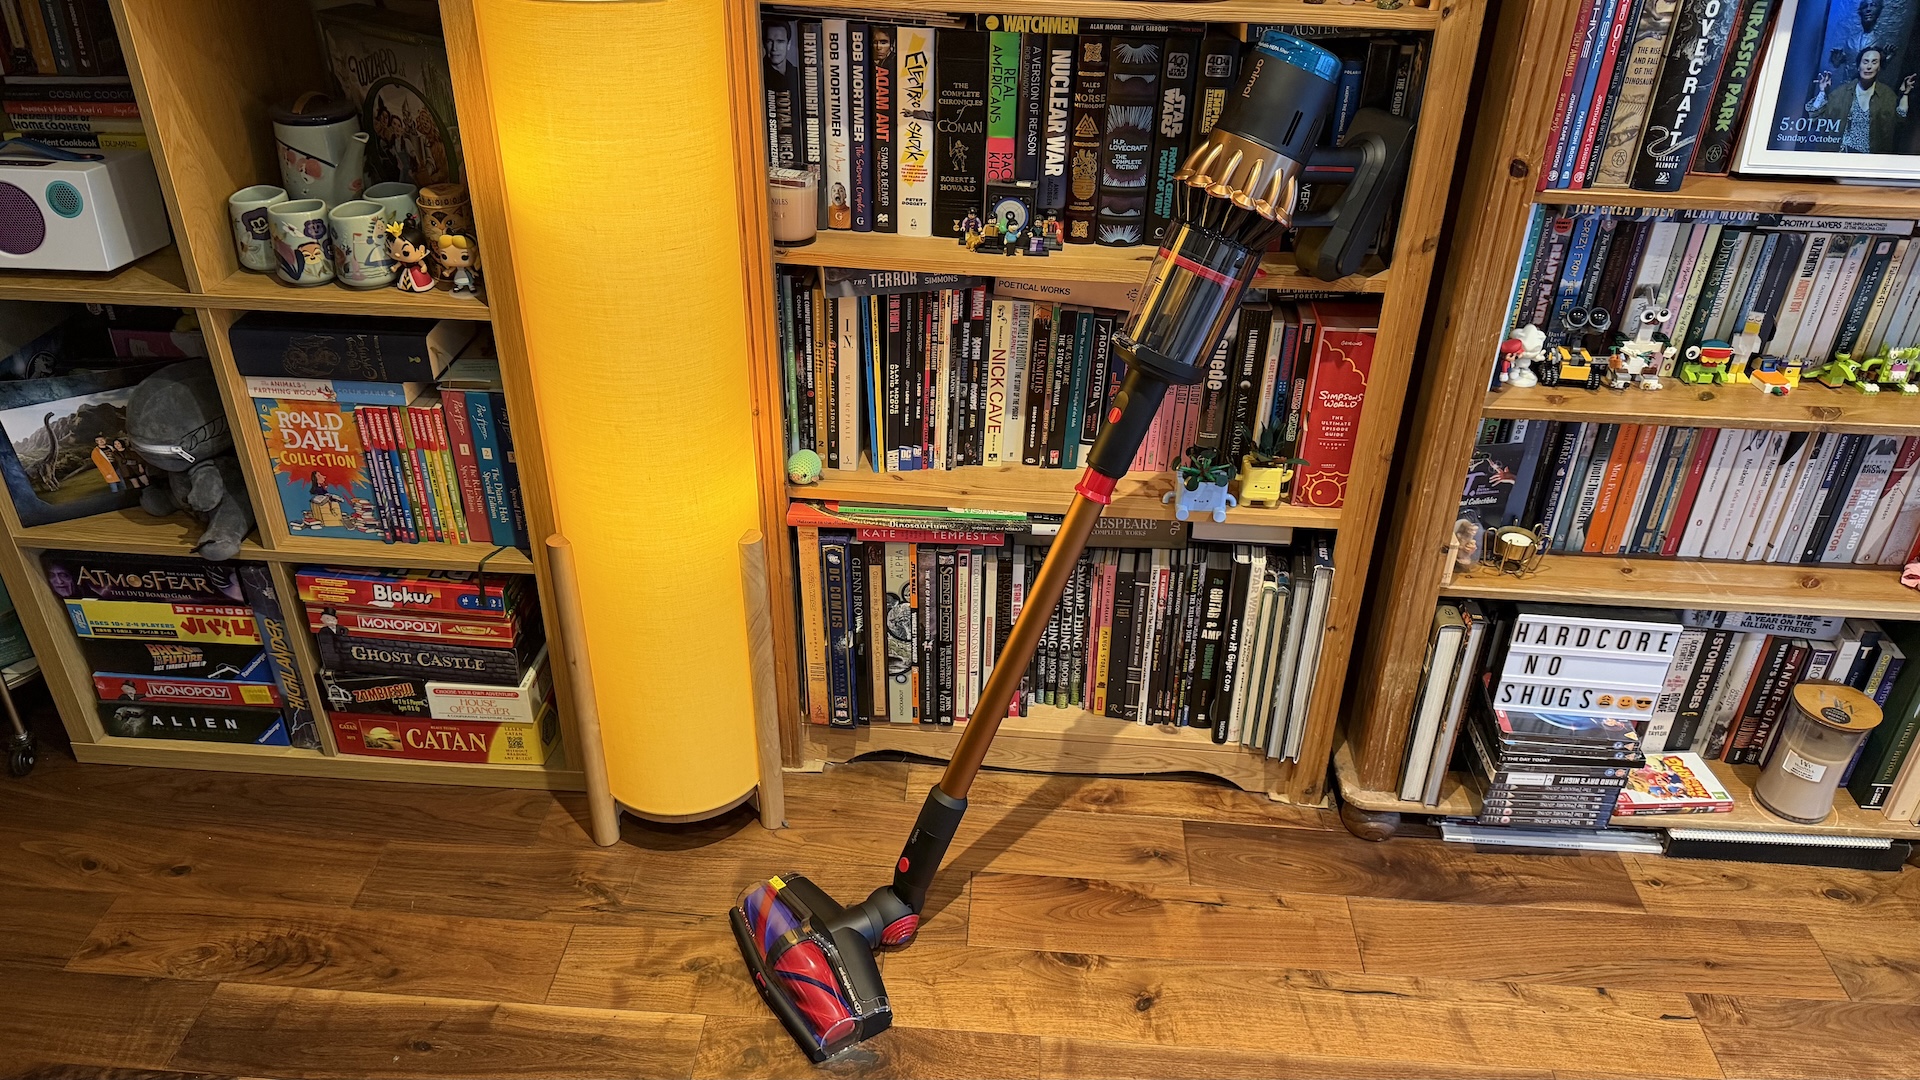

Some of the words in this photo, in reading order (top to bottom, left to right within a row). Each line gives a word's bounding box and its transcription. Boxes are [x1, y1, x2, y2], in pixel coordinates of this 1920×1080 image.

[1003, 15, 1079, 35] WATCHMEN
[1580, 8, 1600, 59] HIVE
[804, 32, 817, 65] DEXYS
[829, 32, 839, 63] BOB
[852, 32, 864, 62] BOB
[1591, 22, 1610, 69] SKULL
[1637, 46, 1648, 54] THE
[1649, 47, 1662, 55] RISE
[1633, 56, 1646, 64] AND
[1646, 57, 1659, 65] FALL
[1634, 67, 1642, 75] OF
[1642, 67, 1653, 75] THE
[804, 66, 819, 115] MIDNIGHT
[875, 67, 890, 110] ADAM
[989, 45, 1003, 124] AMERICANS
[1003, 68, 1016, 101] REAL
[1242, 58, 1265, 98] animal
[48, 91, 91, 100] COSMIC
[830, 65, 842, 137] MORTIMER
[853, 65, 865, 143] MORTIMER
[938, 98, 984, 107] CHRONICLES
[941, 90, 981, 98] COMPLETE
[1047, 50, 1072, 133] NUCLEAR
[1566, 93, 1576, 122] JONATHAN
[877, 113, 890, 142] ANT
[937, 120, 983, 134] CONAN
[1561, 122, 1569, 137] CAPE
[1780, 117, 1813, 133] 5:01
[1816, 118, 1841, 133] PM
[60, 139, 97, 148] Cookbook
[806, 117, 821, 163] RUNNERS
[1109, 144, 1148, 152] LOVECRAFT
[1776, 133, 1807, 145] Sunday,
[1808, 134, 1843, 144] October
[1045, 136, 1066, 177] WAR
[1553, 138, 1564, 168] LONDON
[1579, 218, 1594, 251] CRAZY
[1816, 220, 1843, 229] SAYERS
[1545, 243, 1563, 283] READY
[1571, 253, 1583, 278] FROM
[854, 278, 867, 286] THE
[869, 271, 918, 288] TERROR
[925, 275, 959, 284] SIMMONS
[998, 280, 1039, 291] POETICAL
[1040, 286, 1071, 295] WORKS
[973, 291, 984, 318] MARVEL
[1533, 284, 1552, 325] PLAYER
[1010, 326, 1018, 360] FEARNLEY
[1036, 338, 1047, 357] THE
[1098, 334, 1106, 359] ROCK
[1243, 329, 1258, 376] ILLUMINATIONS
[989, 350, 1007, 388] NICK
[1034, 358, 1046, 394] SMITHS
[1207, 338, 1228, 390] suede
[253, 385, 288, 395] FARTHING
[293, 387, 317, 396] WOOD
[1093, 361, 1104, 400] BOTTOM
[1318, 390, 1364, 402] SIMPSONS
[1324, 400, 1358, 409] WORLD
[275, 410, 344, 432] ROALD
[987, 392, 1005, 434] CAVE
[280, 429, 349, 452] DAHL
[1557, 432, 1576, 465] HARRIS
[1836, 435, 1848, 459] GRAHAM
[279, 450, 357, 469] COLLECTION
[1611, 462, 1623, 482] MOLL
[1827, 460, 1839, 482] GREENE
[1739, 458, 1754, 487] Murakami
[1761, 459, 1776, 488] Murakami
[1782, 461, 1796, 489] Murakami
[1801, 462, 1815, 490] Murakami
[1599, 483, 1617, 514] FLANDERS
[1846, 489, 1861, 509] PHIL
[1854, 489, 1868, 511] FALL
[1865, 488, 1879, 507] THE
[889, 521, 950, 531] Dinosaurium
[1828, 511, 1852, 552] SPECTOR
[1849, 513, 1859, 525] OF
[1855, 509, 1870, 529] RISE
[862, 529, 896, 539] KATE
[932, 532, 988, 543] TEMPEST
[1846, 531, 1860, 550] AND
[77, 565, 215, 594] ATMOSFEAR
[830, 568, 840, 583] DC
[940, 566, 952, 604] SCIENCE
[1075, 565, 1086, 611] SWAMP
[1252, 567, 1262, 593] STAR
[373, 584, 435, 606] Blokus
[830, 587, 843, 628] COMICS
[1206, 588, 1224, 620] GUITAR
[940, 604, 953, 643] FICTION
[1206, 620, 1218, 629] &
[1247, 596, 1258, 629] WARS
[1754, 616, 1776, 624] YEAR
[1795, 620, 1814, 628] THE
[360, 618, 439, 634] MONOPOLY
[958, 614, 966, 647] WORLD
[1072, 612, 1084, 649] THING
[1200, 629, 1223, 641] AMP
[1515, 623, 1674, 654] HARDCORE
[1740, 621, 1775, 632] KILLING
[1777, 625, 1818, 635] STREETS
[351, 646, 412, 665] GHOST
[416, 653, 487, 671] CASTLE
[957, 648, 966, 667] WAR
[970, 624, 979, 669] DINOSAURS
[1705, 638, 1725, 675] STONE
[264, 618, 306, 711] HIGHLANDER
[1072, 658, 1082, 683] MOORE
[1524, 655, 1562, 676] NO
[152, 684, 230, 700] MONOPOLY
[354, 681, 418, 703] ZOMBIES!!!
[1688, 675, 1708, 710] ROSES
[1772, 663, 1795, 702] ANDRE
[459, 698, 498, 707] HOUSE
[1501, 684, 1593, 710] SHUGS
[151, 716, 240, 730] ALIEN
[449, 705, 463, 714] OF
[464, 706, 511, 716] DANGER
[406, 728, 489, 753] CATAN
[1754, 710, 1776, 746] GIANT
